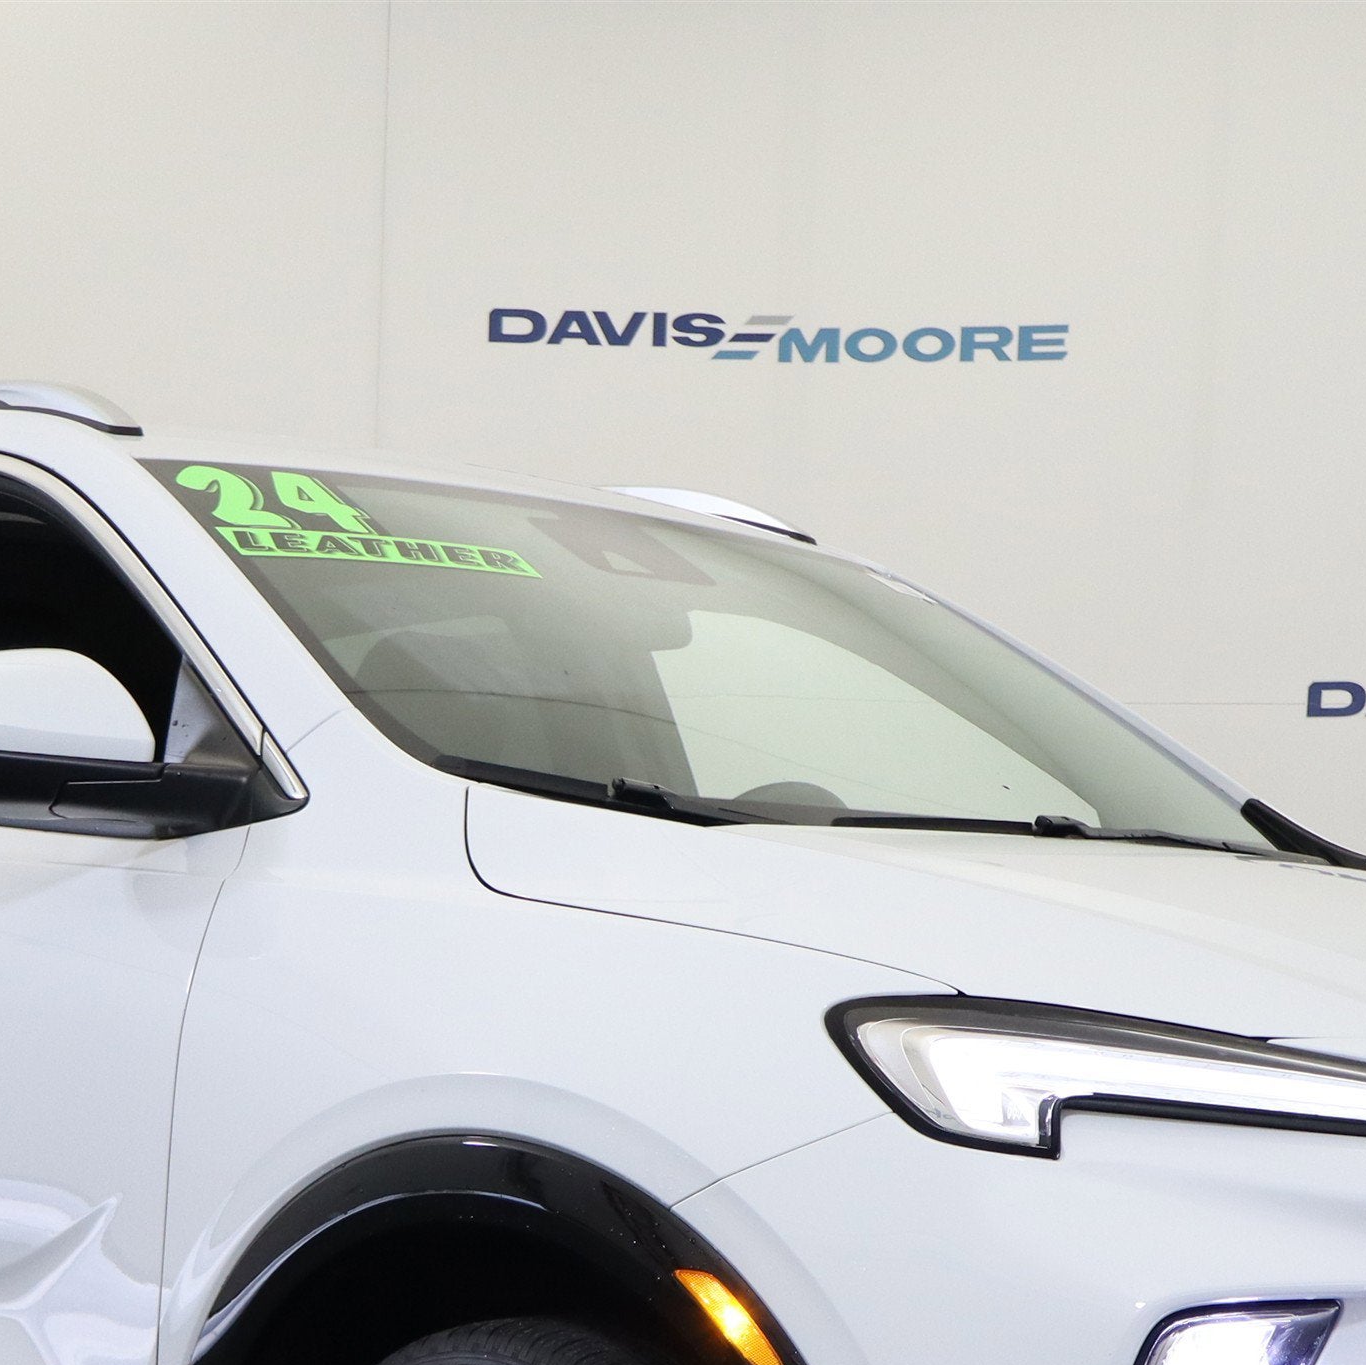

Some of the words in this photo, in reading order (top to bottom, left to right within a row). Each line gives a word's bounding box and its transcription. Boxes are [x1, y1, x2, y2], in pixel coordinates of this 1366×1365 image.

[487, 307, 726, 348] DAVIS
[777, 324, 1070, 363] MOORE
[175, 464, 377, 536] 24
[229, 528, 529, 573] LEATHER
